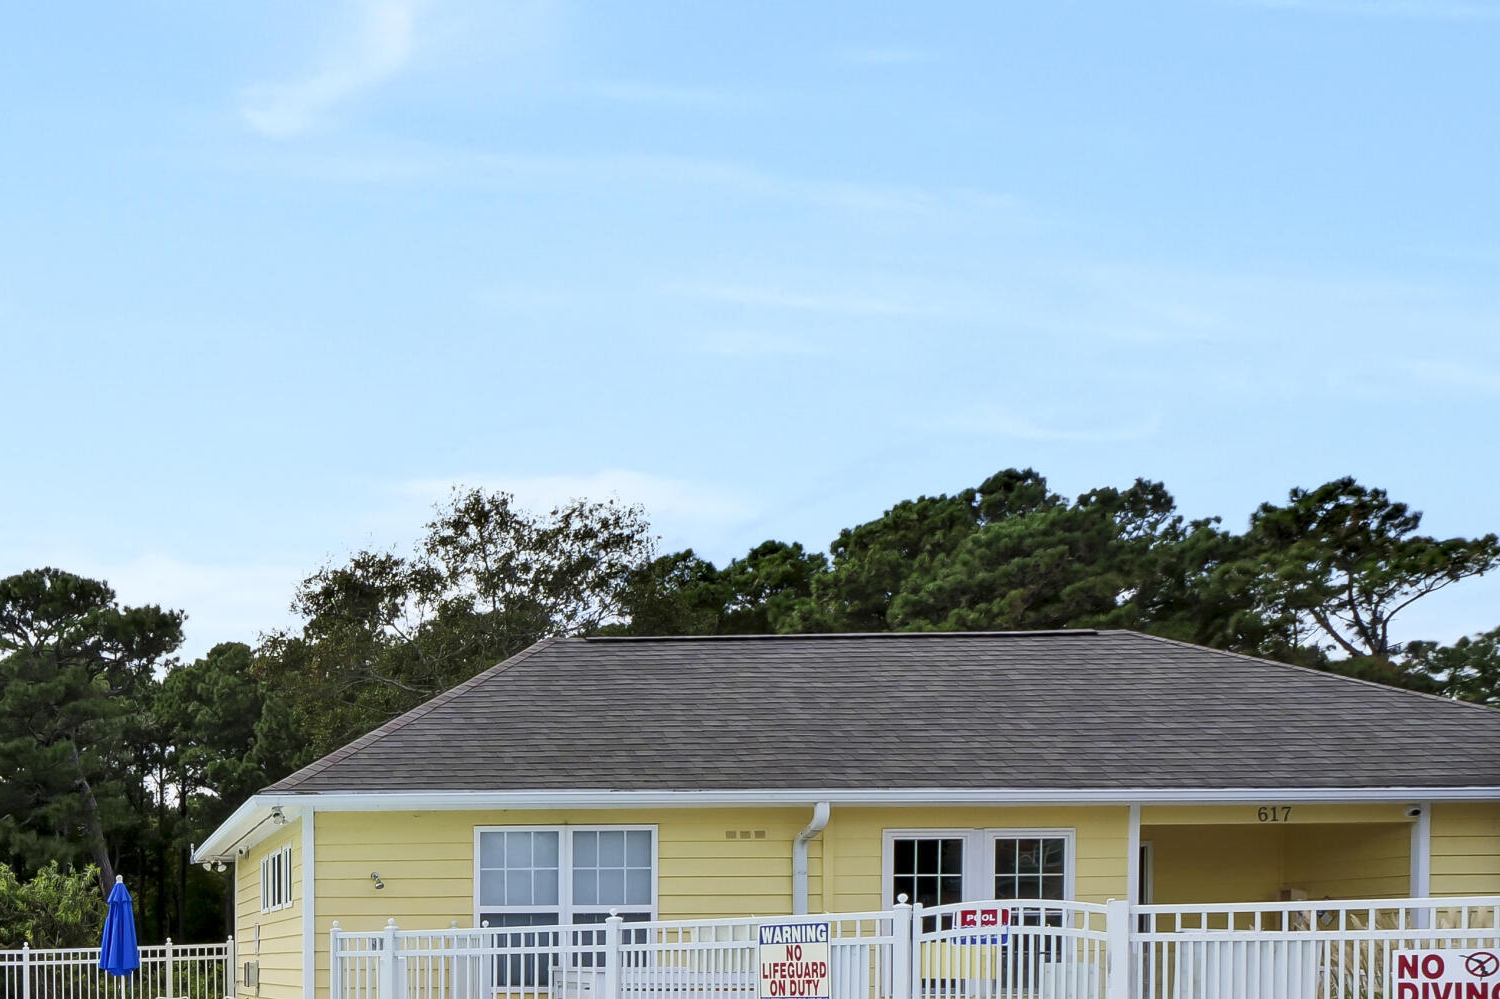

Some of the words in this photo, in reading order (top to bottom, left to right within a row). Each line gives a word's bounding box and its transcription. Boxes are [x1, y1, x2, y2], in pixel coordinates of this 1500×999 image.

[1258, 806, 1292, 822] 617
[761, 924, 827, 944] WARNING
[786, 945, 802, 961] NO
[762, 962, 827, 979] LIFEGUARD
[1398, 954, 1445, 979] NO
[769, 980, 786, 996] ON
[790, 979, 820, 996] DUTY
